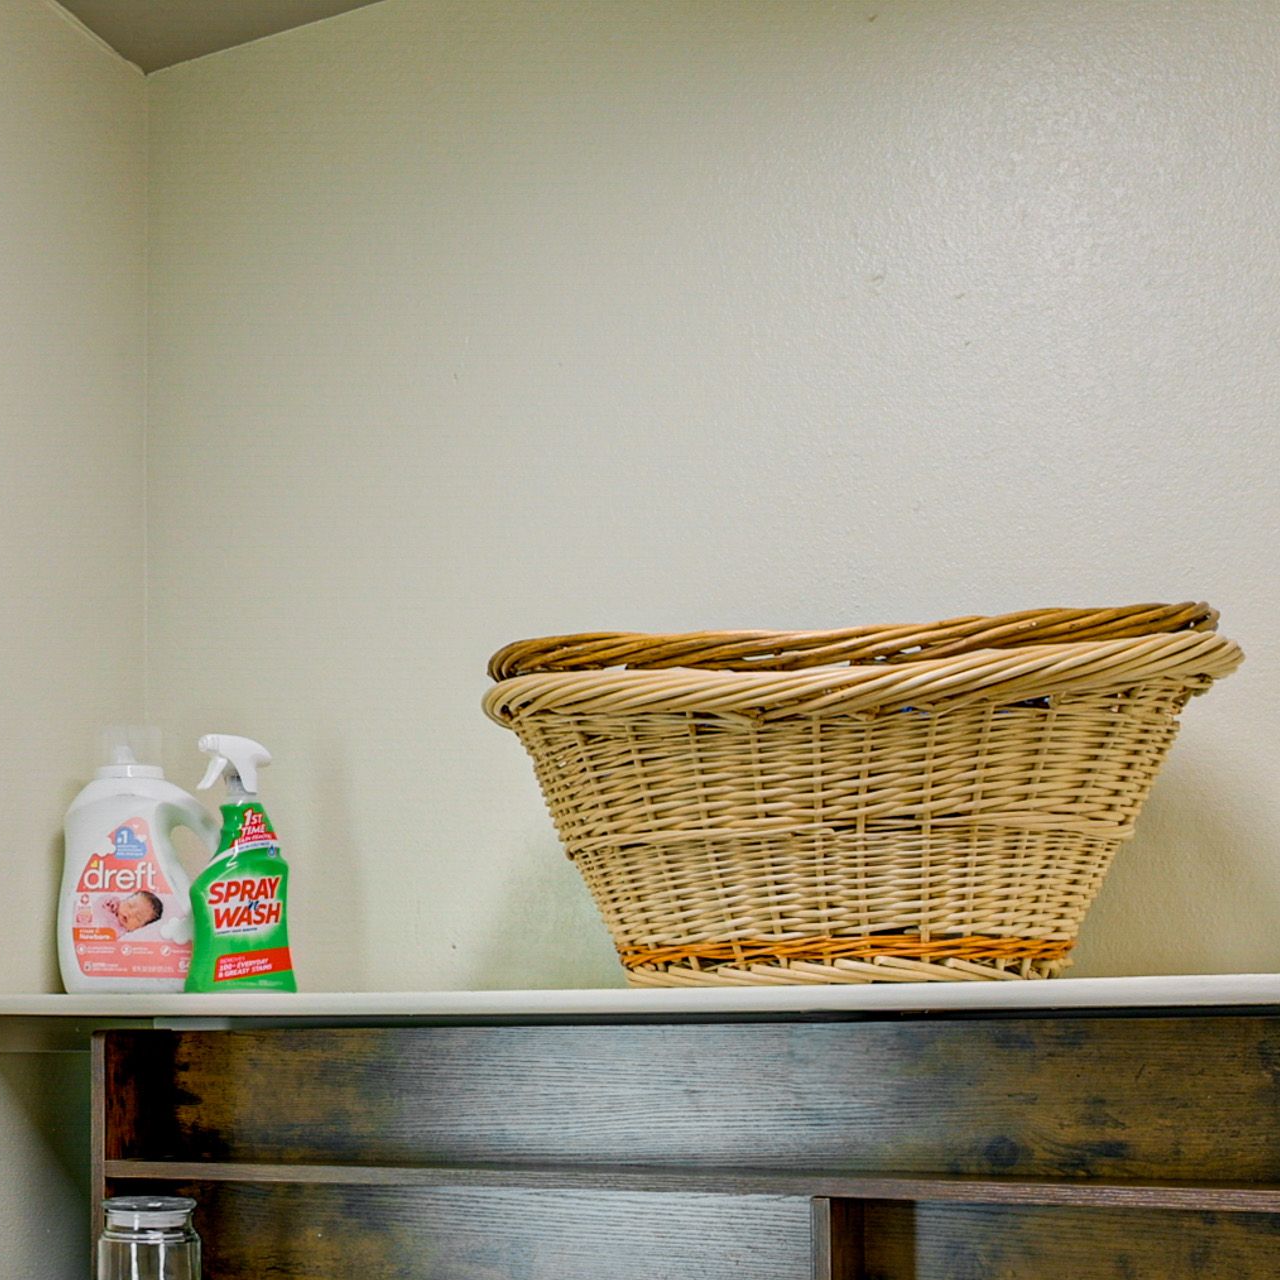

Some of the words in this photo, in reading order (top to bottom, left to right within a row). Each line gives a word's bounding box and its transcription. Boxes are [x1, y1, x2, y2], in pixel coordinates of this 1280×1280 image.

[242, 823, 266, 836] TIME
[83, 860, 156, 890] dreft
[208, 877, 281, 904] SPRAY
[214, 902, 281, 930] WASH
